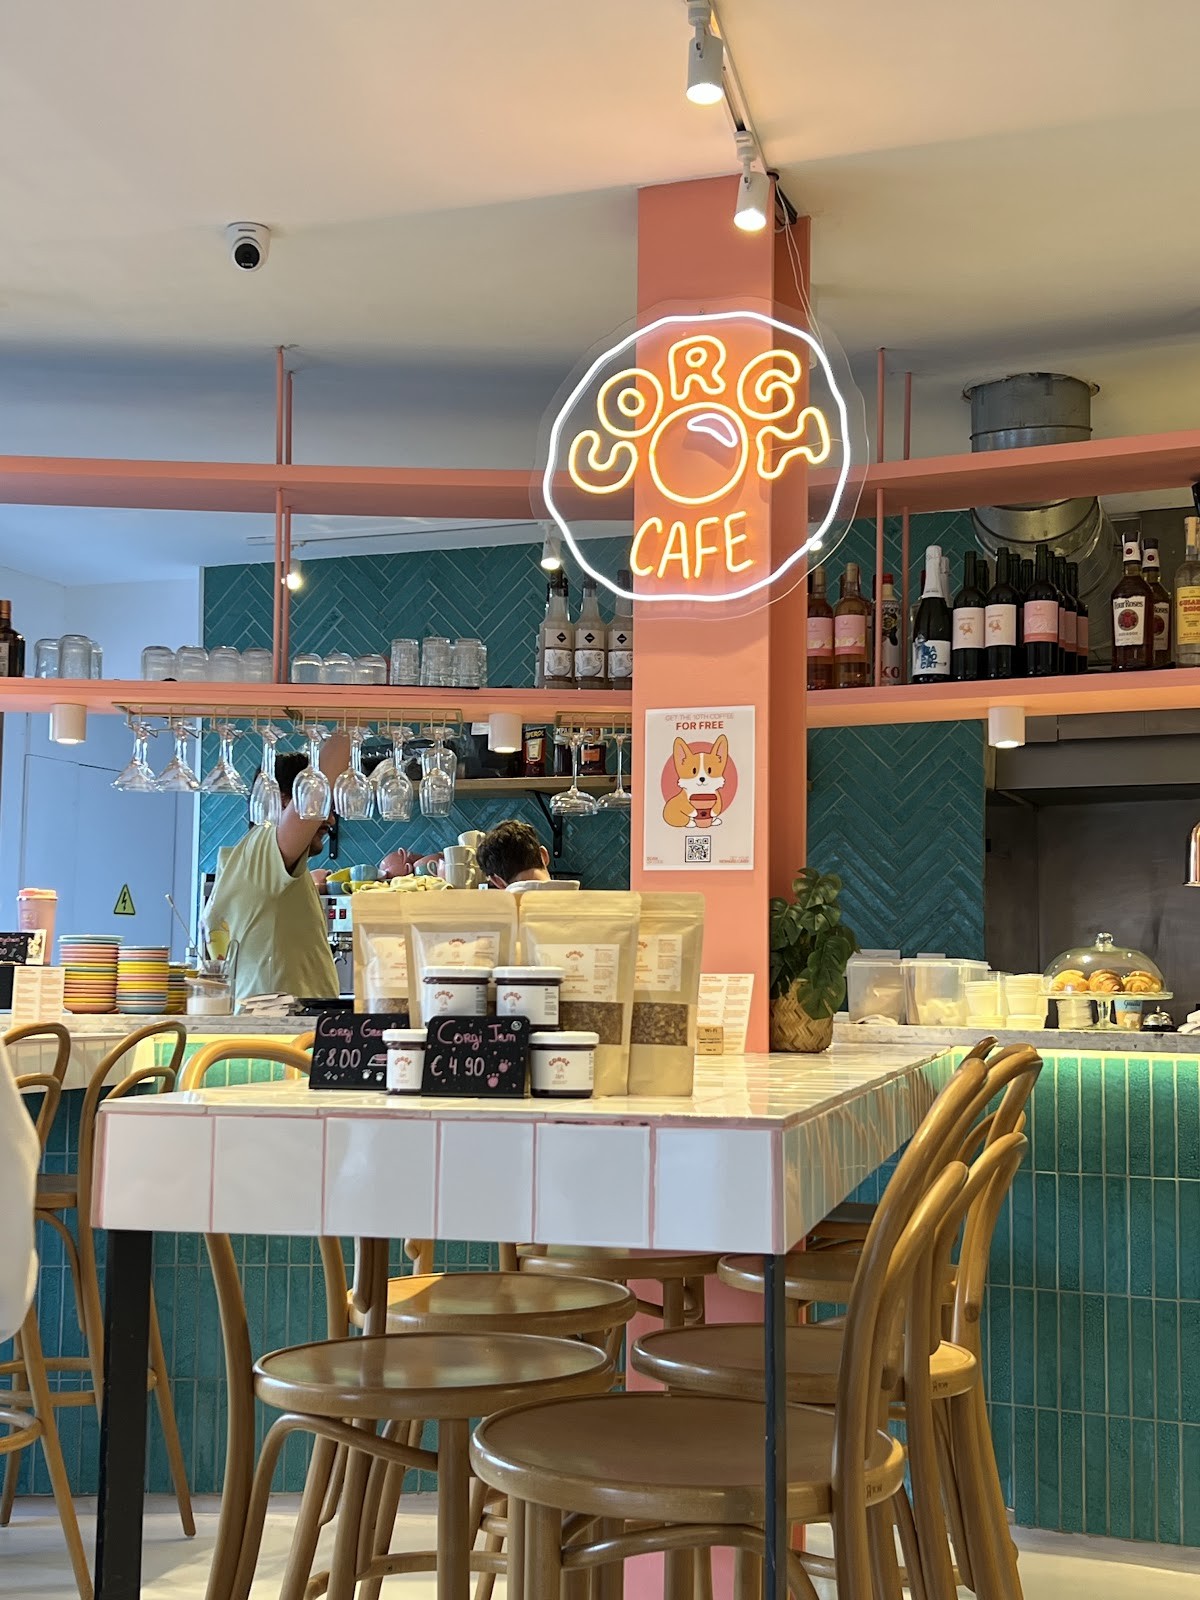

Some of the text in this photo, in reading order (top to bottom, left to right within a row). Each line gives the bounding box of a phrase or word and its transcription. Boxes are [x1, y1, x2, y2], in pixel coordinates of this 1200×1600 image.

[568, 334, 831, 495] CORGI
[629, 511, 754, 579] CAFE
[676, 720, 724, 730] FOR FREE
[437, 1019, 482, 1051] Corgi
